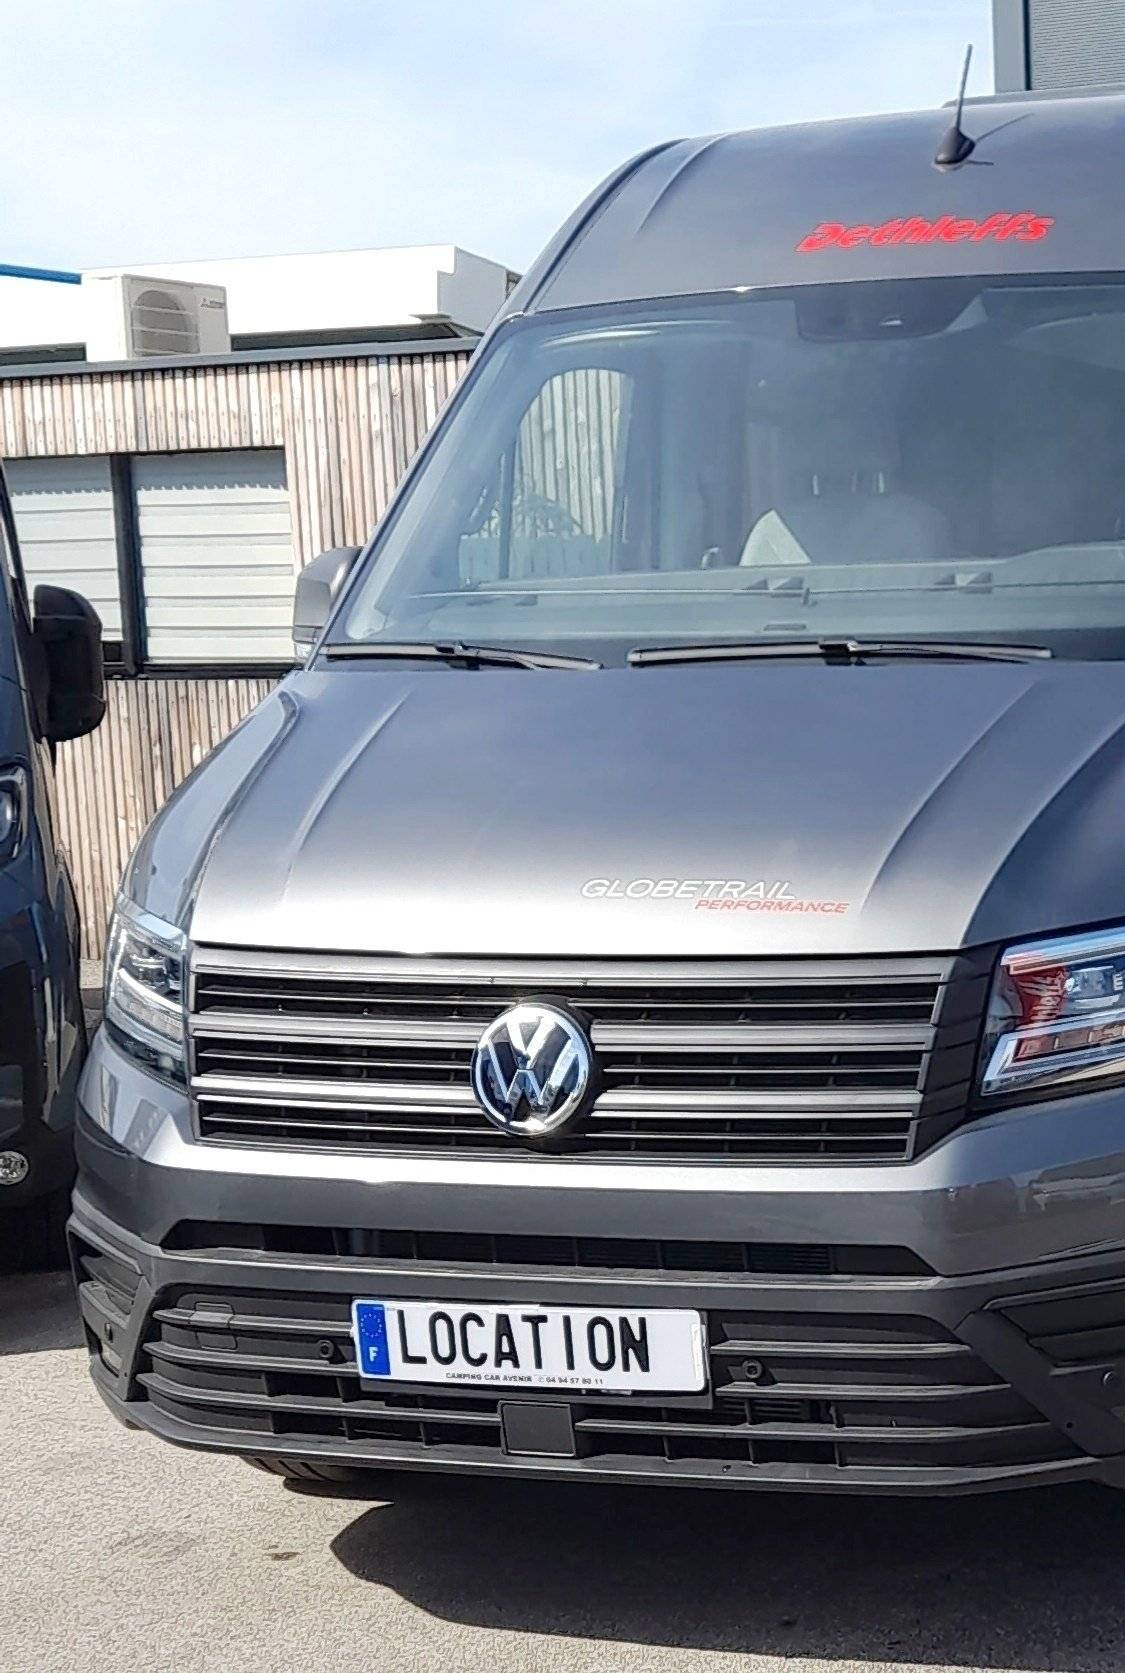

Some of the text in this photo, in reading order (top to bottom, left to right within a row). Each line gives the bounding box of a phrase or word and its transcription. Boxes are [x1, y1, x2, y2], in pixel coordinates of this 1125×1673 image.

[796, 209, 1054, 252] Dethleffs
[581, 878, 797, 900] GLOBETRAIL
[694, 899, 850, 914] PERFORMANCE
[368, 1309, 651, 1373] F LOCATION
